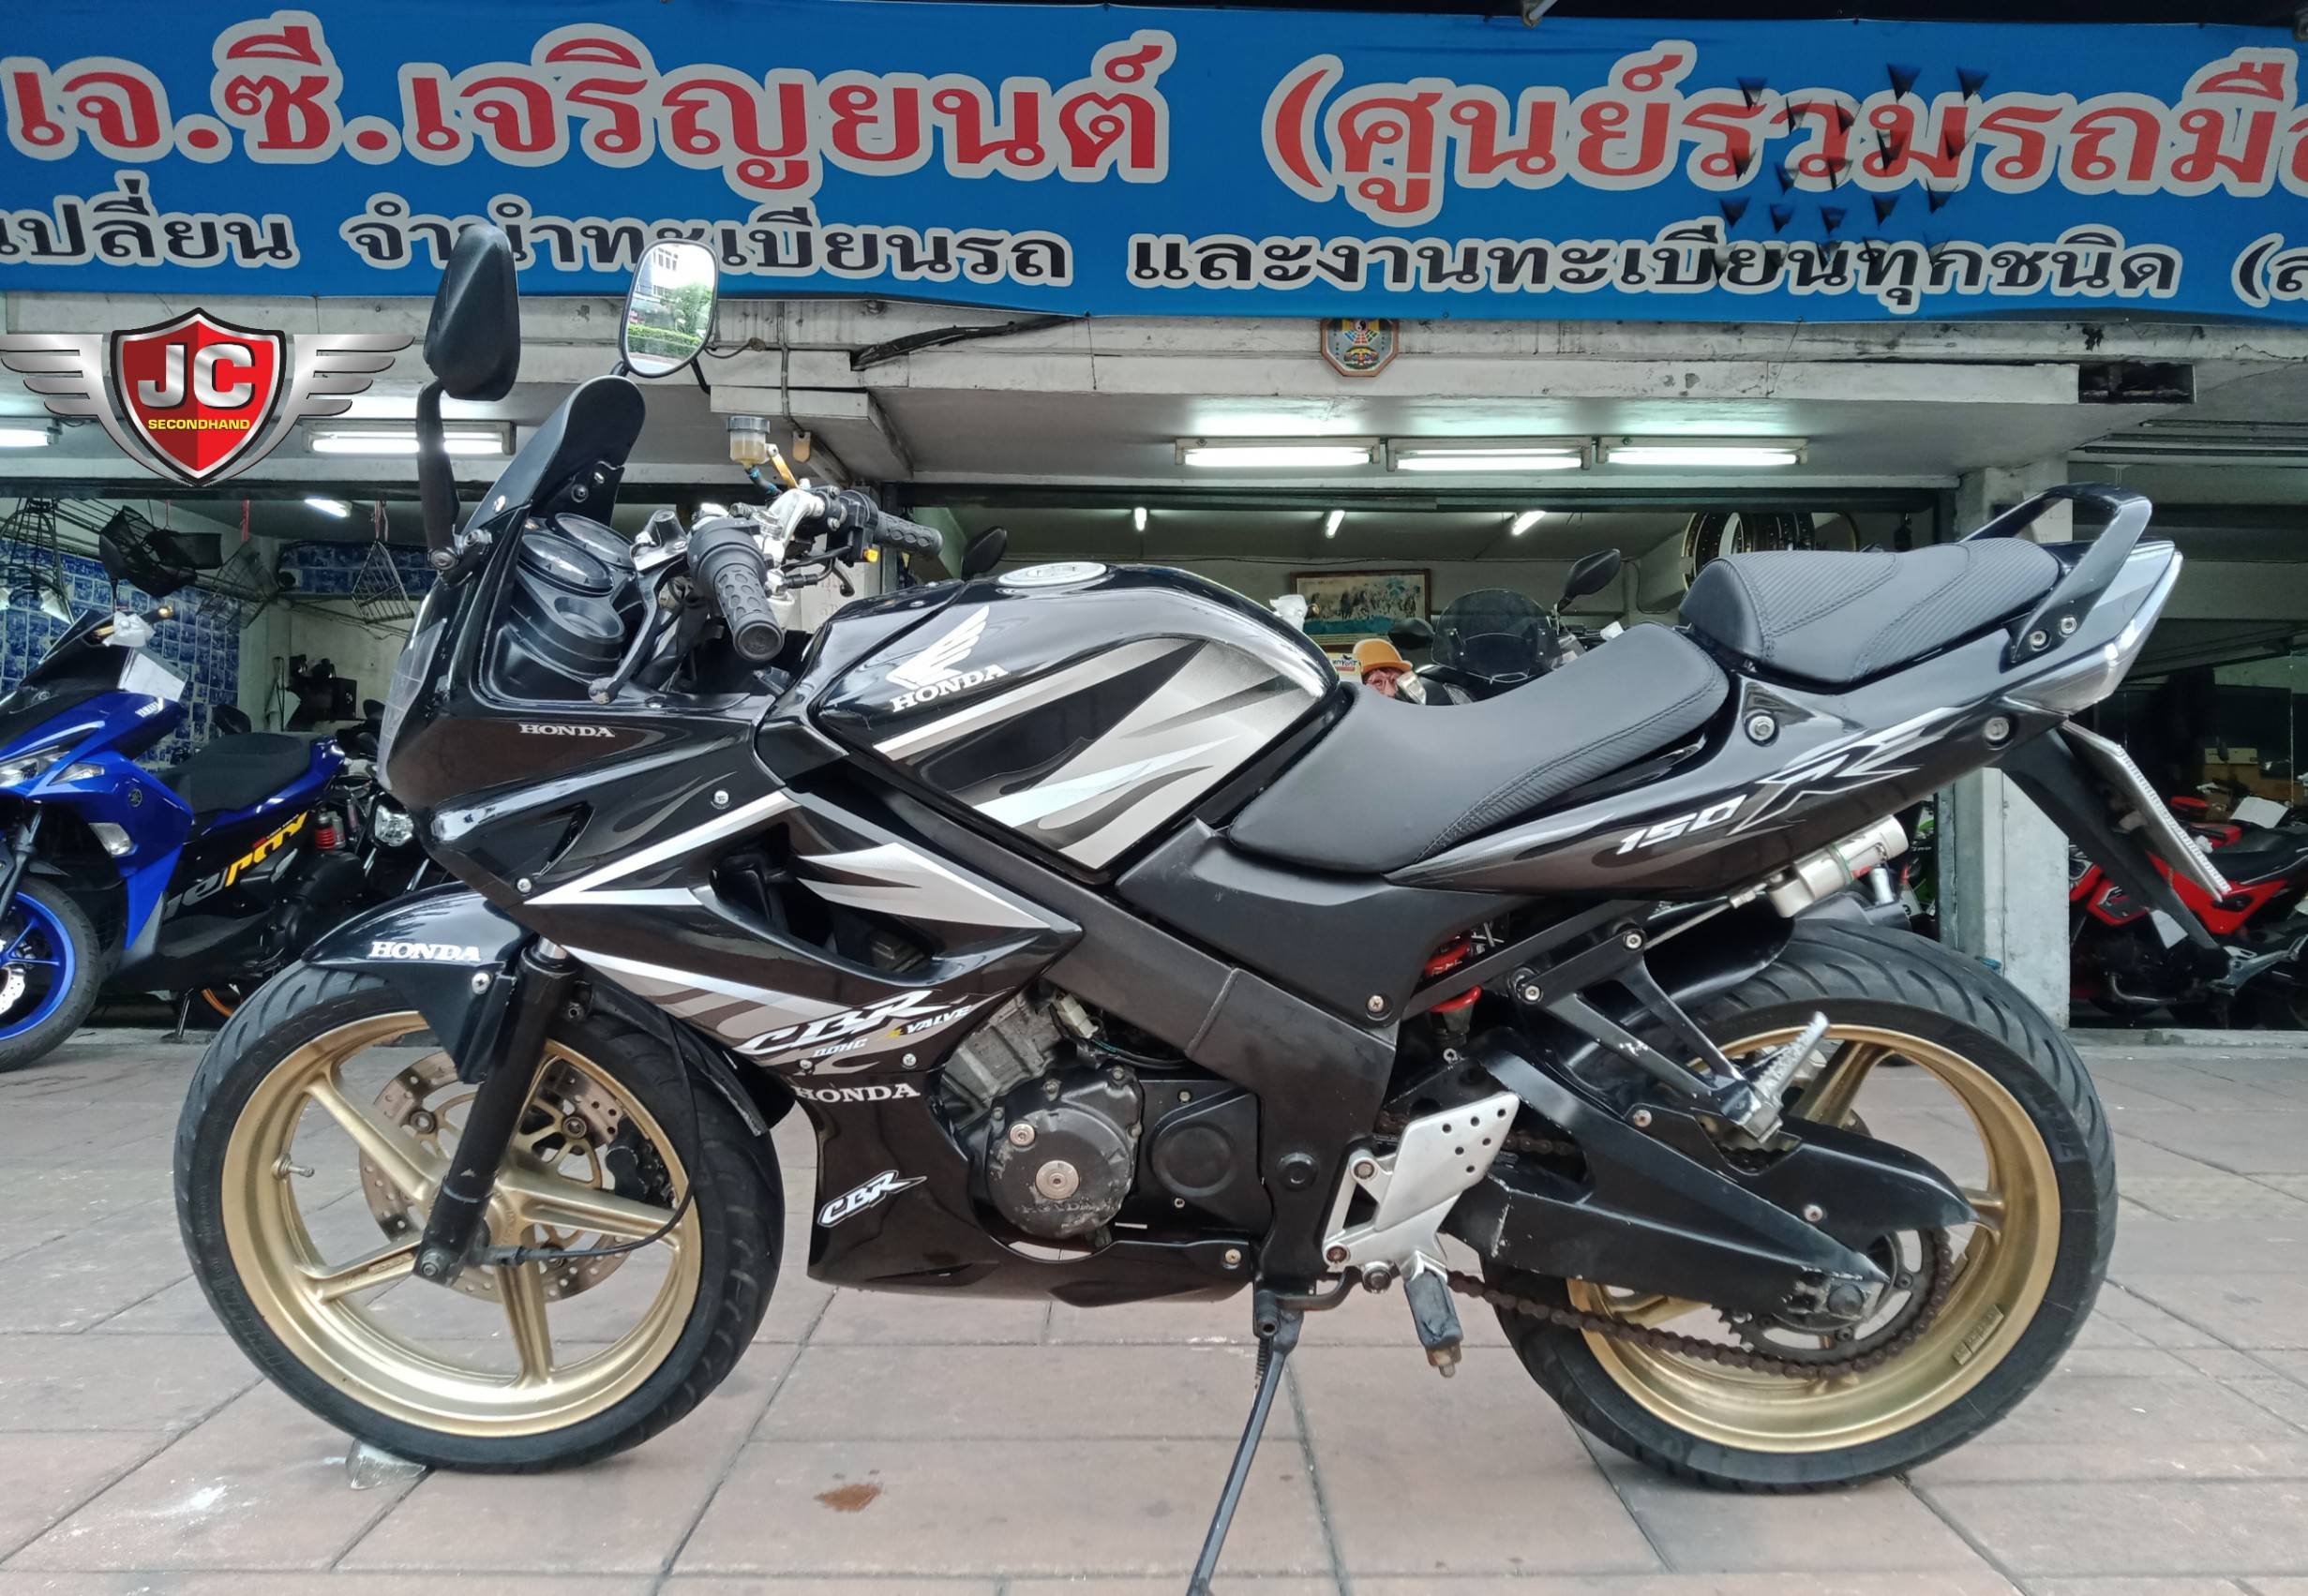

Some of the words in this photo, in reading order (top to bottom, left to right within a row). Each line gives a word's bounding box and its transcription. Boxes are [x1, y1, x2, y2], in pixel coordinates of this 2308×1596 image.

[13, 24, 1156, 190] เจ.ซี.เจริญยนต์
[1274, 53, 2308, 214] (ศูนย์รวมรถมื
[1134, 223, 2175, 306] และงานทะเบียนทุกชนิด
[890, 663, 1011, 713] HONDA
[518, 723, 615, 738] HONDA
[1616, 794, 1747, 856] 150
[366, 941, 481, 962] HONDA
[733, 989, 952, 1056] CBR
[812, 1037, 868, 1058] DOHC
[906, 1004, 972, 1035] VALVE
[791, 1082, 921, 1103] HONDA
[819, 1171, 920, 1226] CBR
